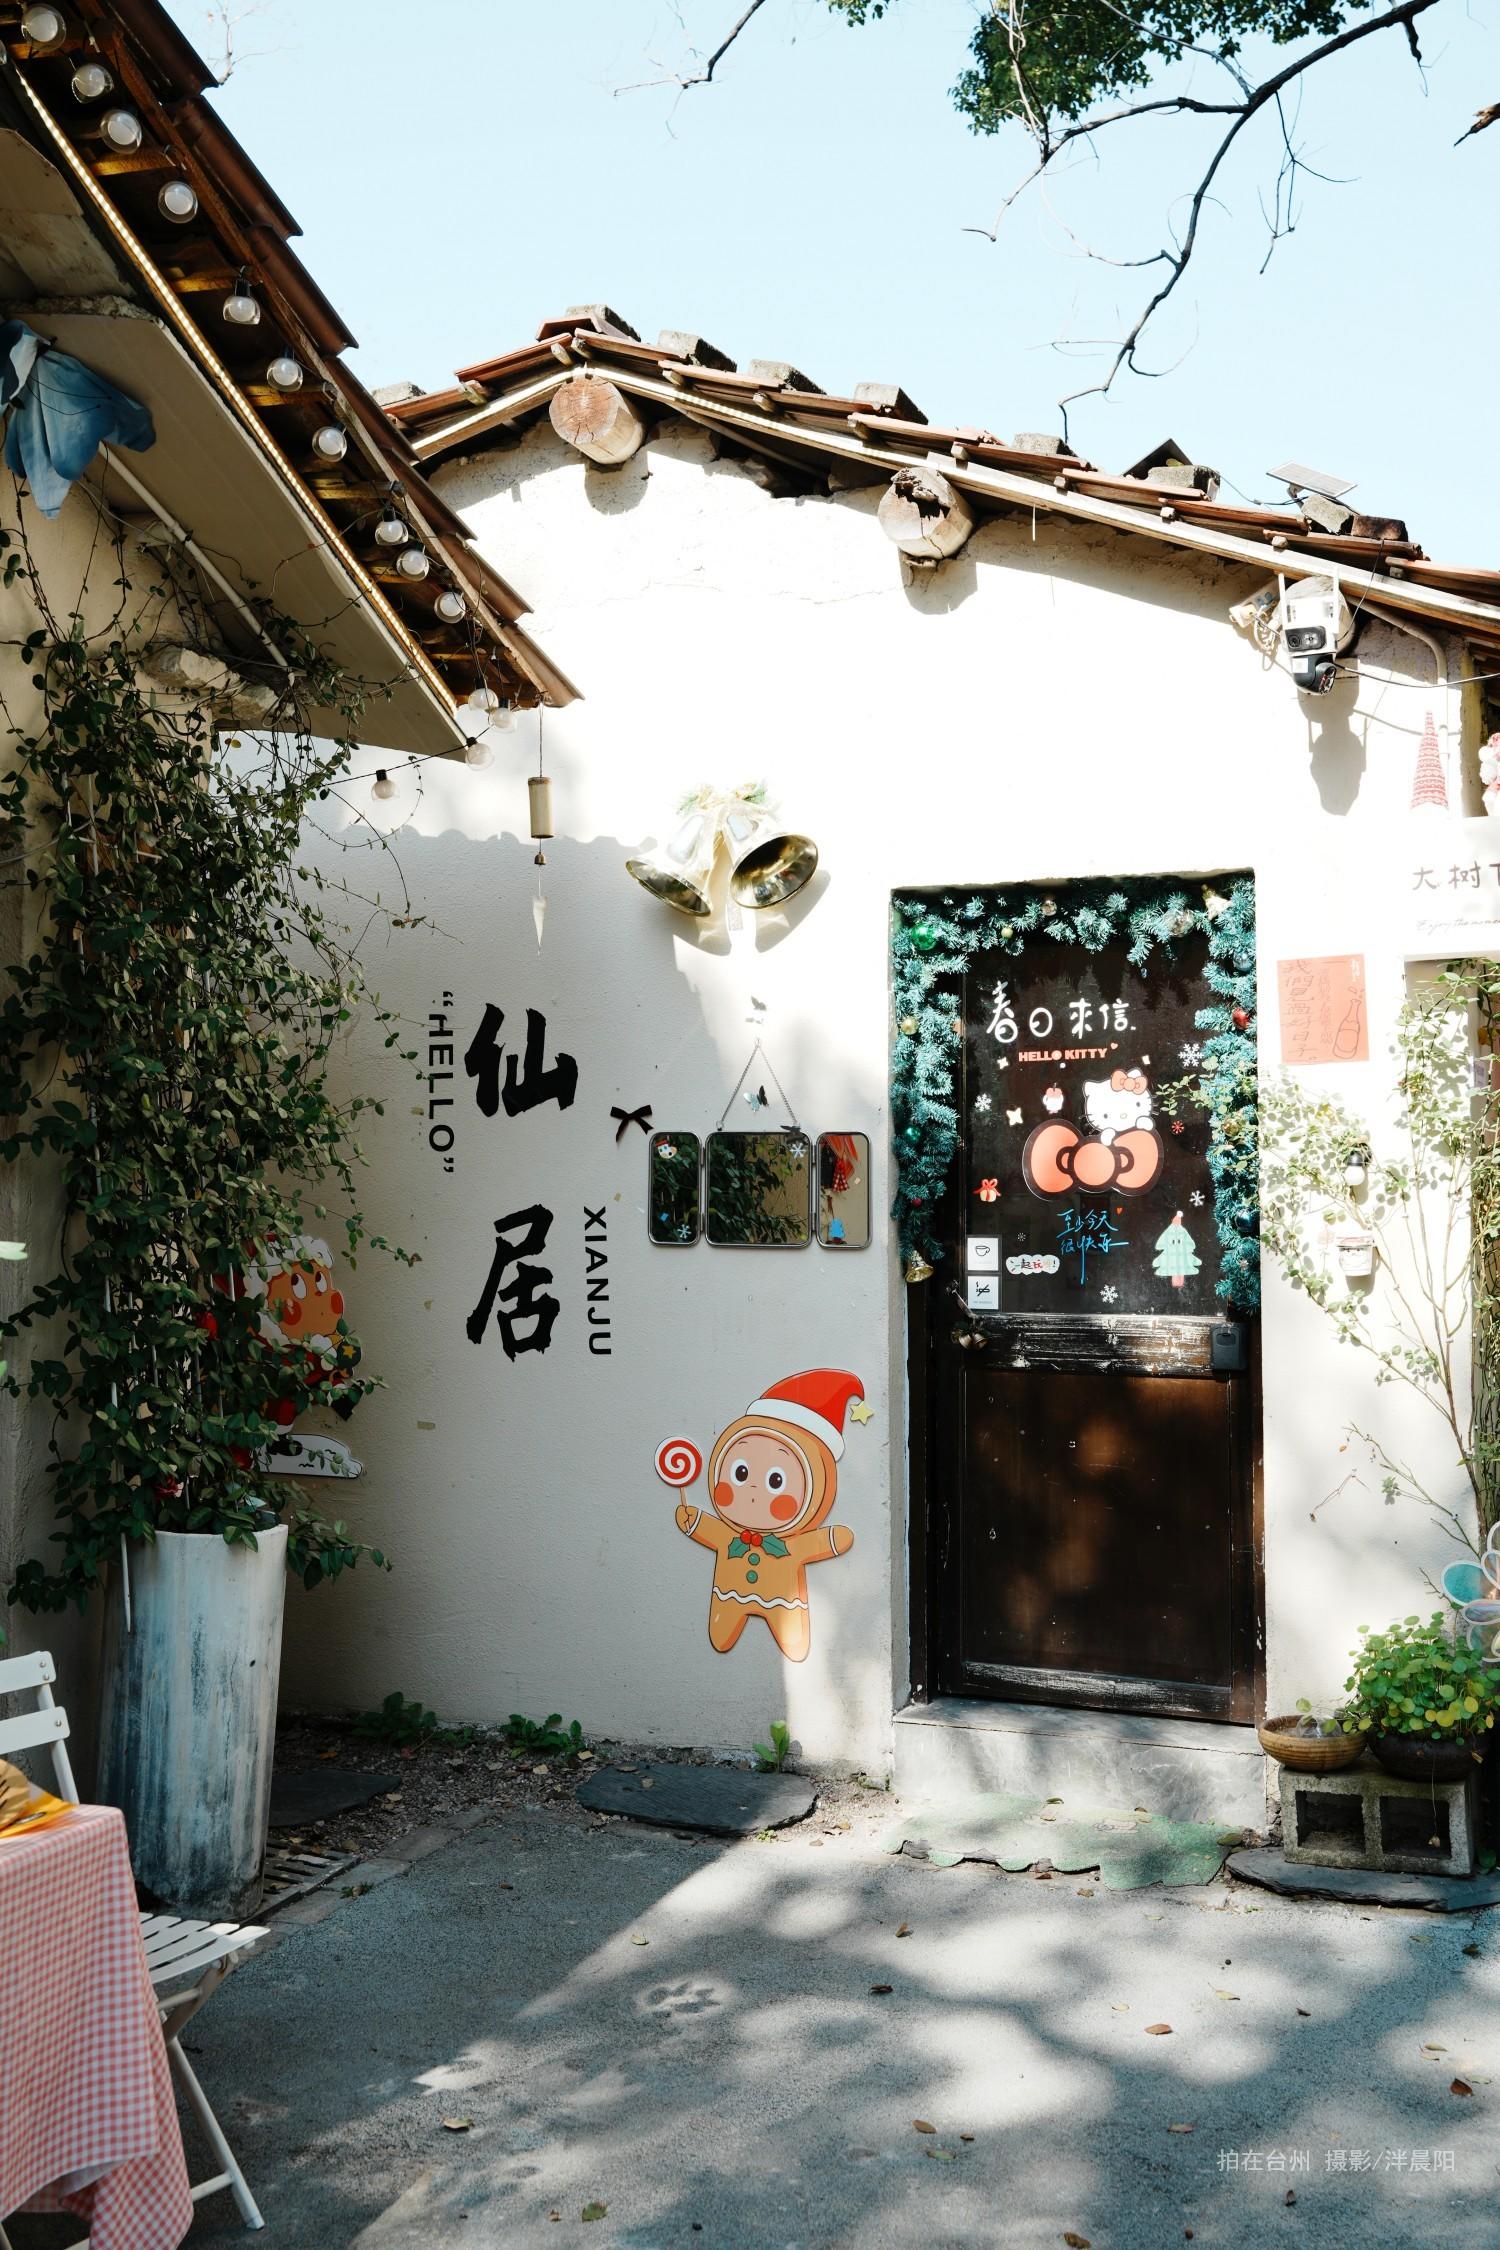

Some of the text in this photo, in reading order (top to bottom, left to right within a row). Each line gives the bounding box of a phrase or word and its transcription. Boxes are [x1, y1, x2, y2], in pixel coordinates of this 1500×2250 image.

[1018, 1047, 1108, 1062] HELLO KITTY
[583, 1205, 612, 1356] XIANJU
